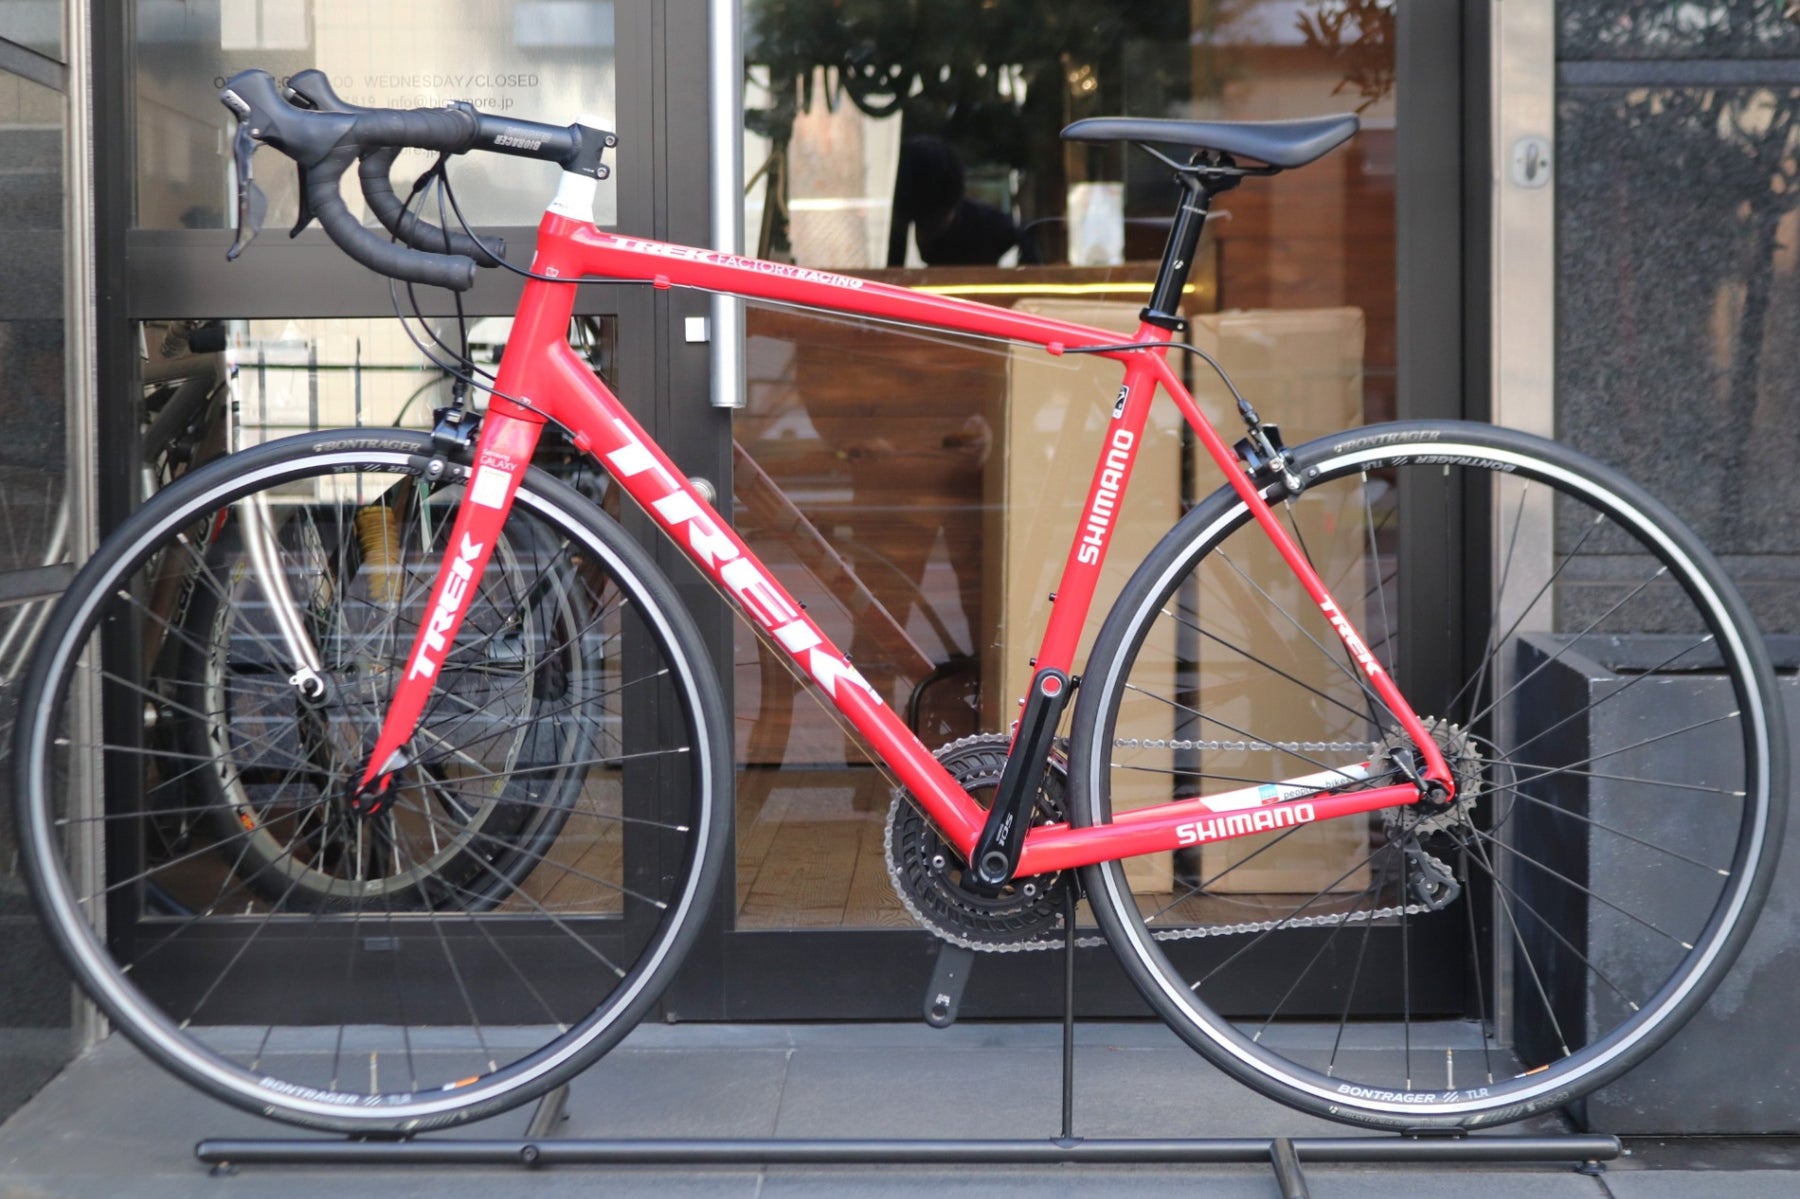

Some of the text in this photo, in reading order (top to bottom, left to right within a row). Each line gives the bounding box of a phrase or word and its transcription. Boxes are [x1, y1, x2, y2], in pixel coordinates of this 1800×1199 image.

[363, 74, 539, 89] WEDNESDAY/CLOSED
[610, 236, 716, 262] TREK
[326, 439, 421, 452] BONTRAGER
[1341, 430, 1440, 451] BONTRAGER
[1415, 454, 1516, 472] BONTRAGER
[1077, 429, 1134, 566] SHIMANO
[606, 418, 884, 706] TREK
[409, 531, 484, 681] TREK
[1320, 594, 1383, 676] TREK
[1176, 803, 1315, 845] SHIMANO
[1337, 1084, 1489, 1103] BONTRAGER TLR
